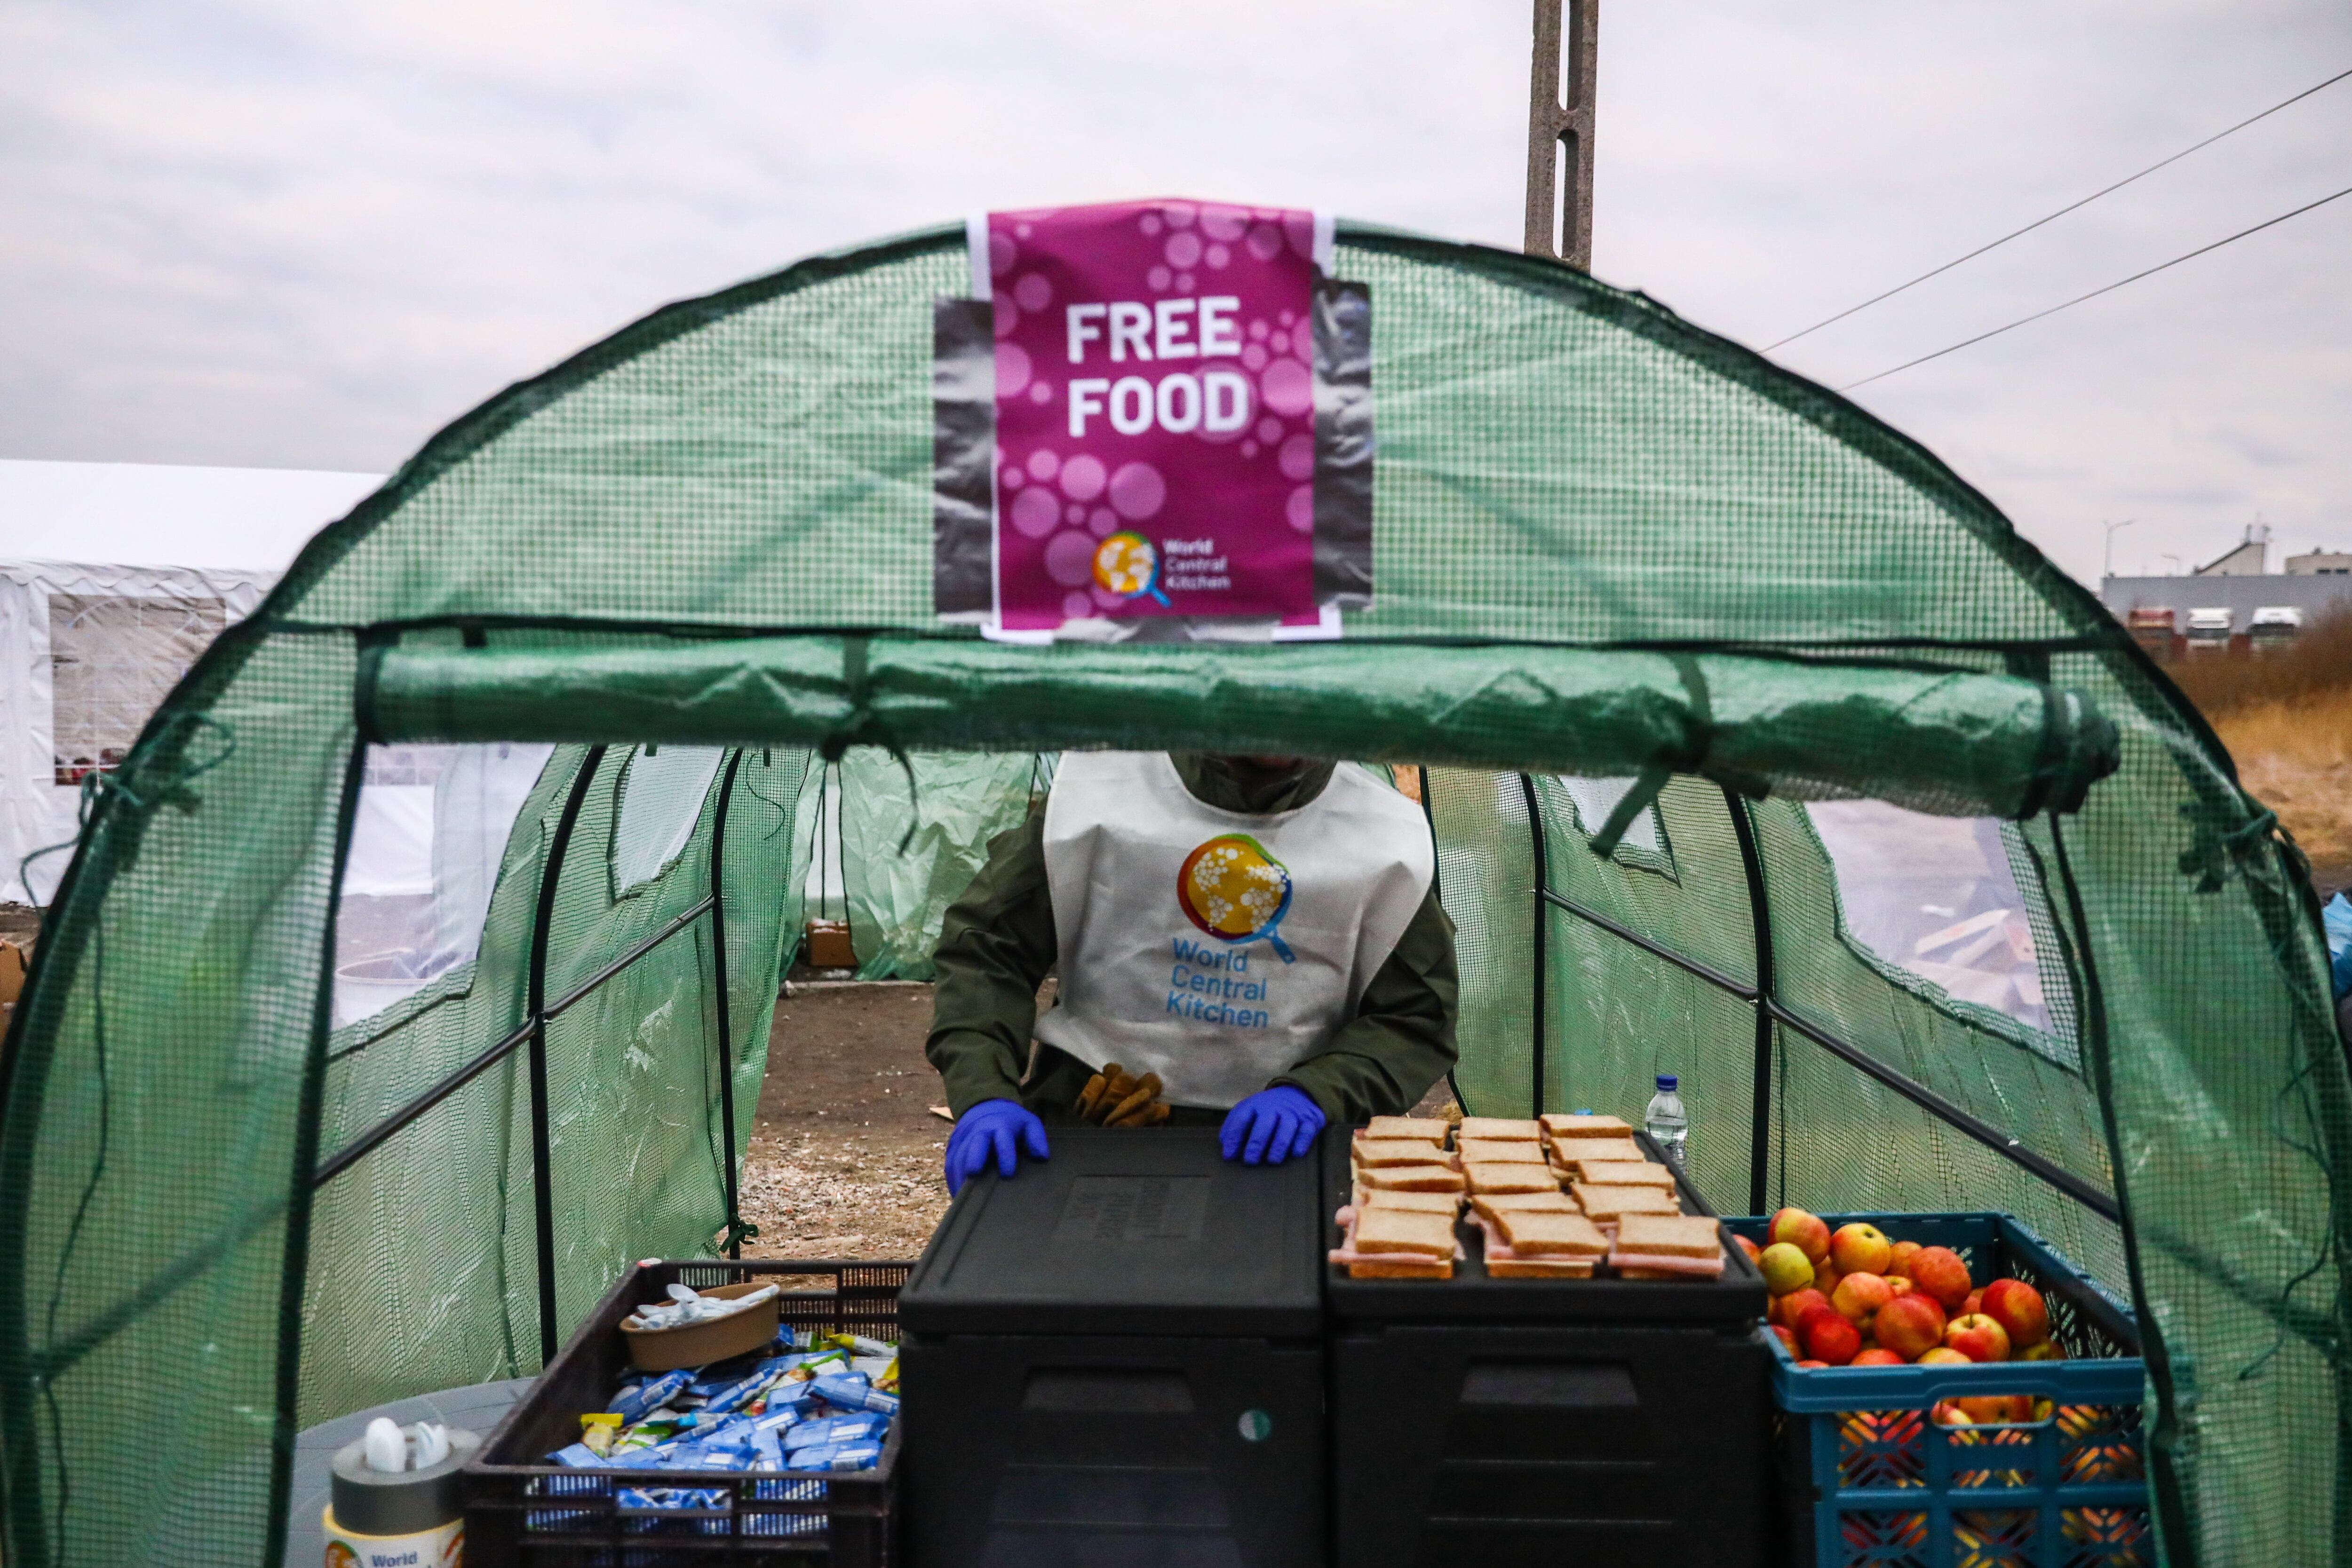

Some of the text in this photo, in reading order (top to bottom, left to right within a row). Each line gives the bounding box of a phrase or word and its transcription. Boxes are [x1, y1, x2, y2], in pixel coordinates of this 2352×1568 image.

[1067, 296, 1242, 364] FREE
[1068, 373, 1248, 438] FOOD
[1163, 538, 1213, 555] World
[1166, 555, 1228, 572] Central
[1166, 575, 1232, 590] Kitchen
[1173, 937, 1248, 972] World
[1172, 965, 1266, 1001] Central
[1166, 990, 1268, 1028] Kitchen
[372, 1552, 417, 1568] World
